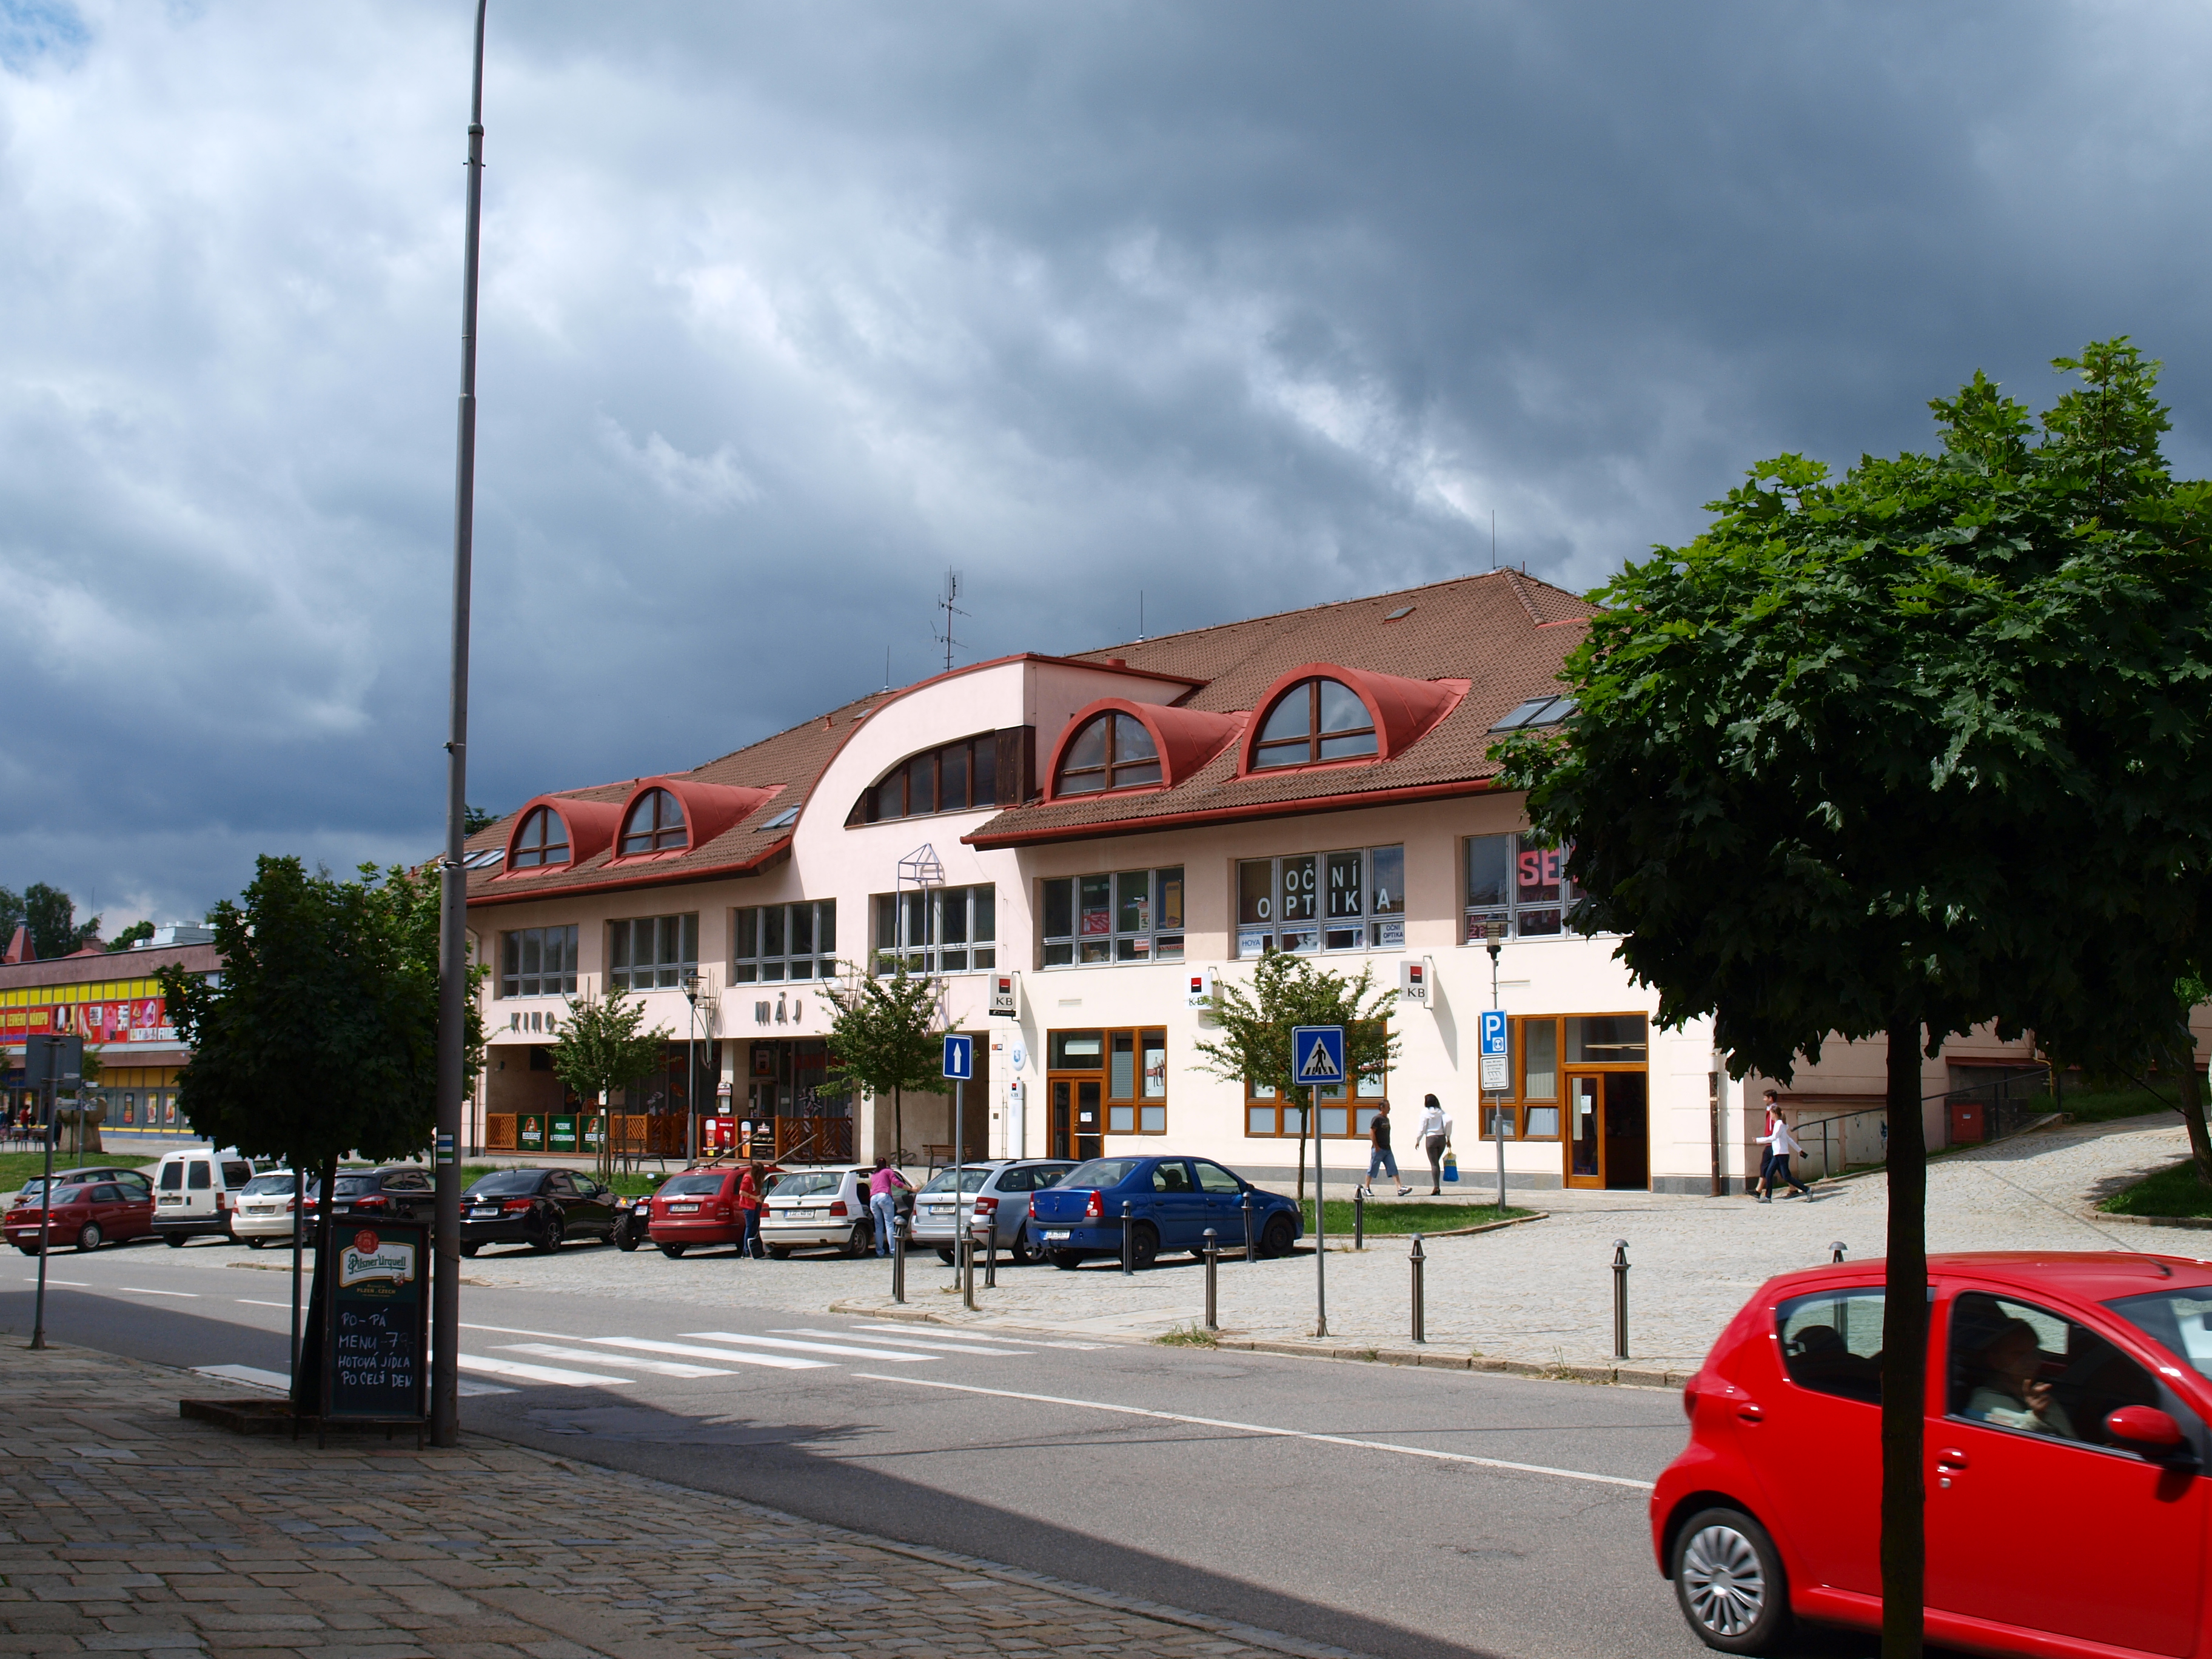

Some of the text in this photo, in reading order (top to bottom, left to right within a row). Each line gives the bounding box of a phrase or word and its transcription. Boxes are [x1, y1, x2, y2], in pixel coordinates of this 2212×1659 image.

[1285, 860, 1358, 892] OČNÍ
[1257, 888, 1390, 919] OPTIKA
[996, 997, 1013, 1006] KB
[1407, 988, 1425, 997] KB
[510, 991, 802, 1033] KINO MÁJ
[1486, 1015, 1501, 1041] P
[348, 1253, 406, 1275] Pilsner Urquell
[338, 1335, 377, 1350] MENU
[338, 1351, 411, 1369] HOTOVÁ JÍDLA
[341, 1370, 357, 1386] PO
[392, 1373, 413, 1388] DEN
